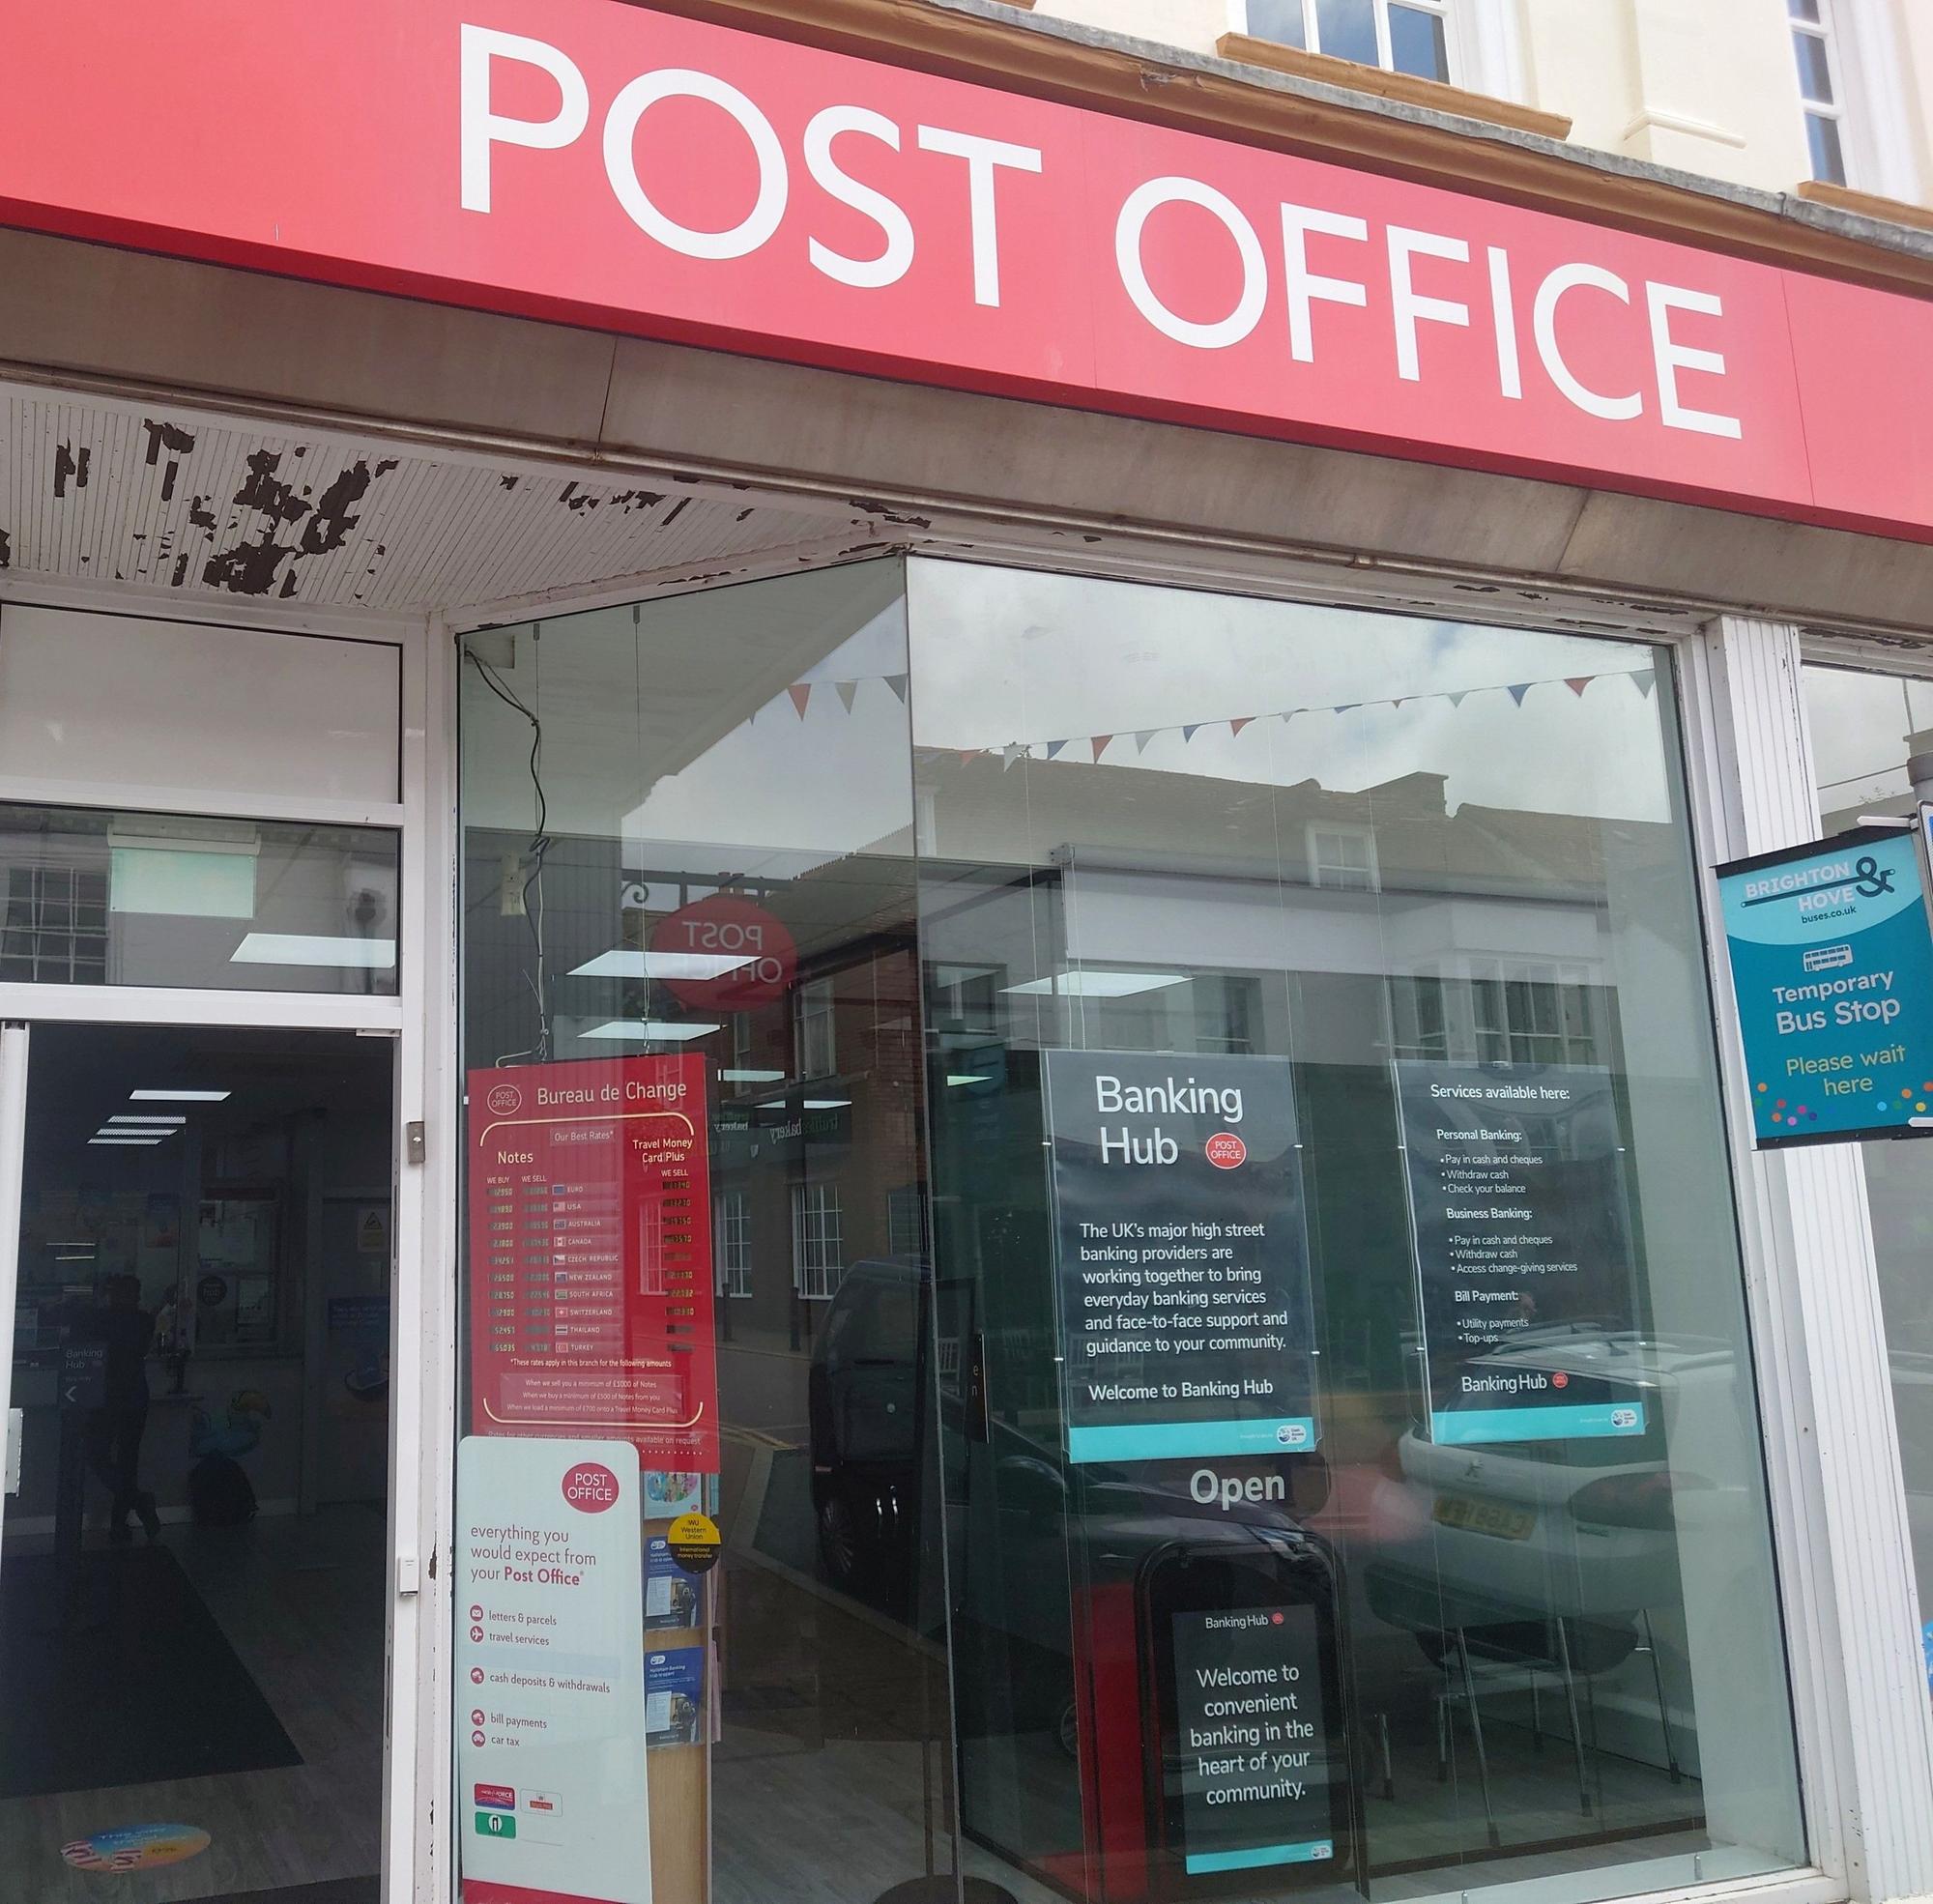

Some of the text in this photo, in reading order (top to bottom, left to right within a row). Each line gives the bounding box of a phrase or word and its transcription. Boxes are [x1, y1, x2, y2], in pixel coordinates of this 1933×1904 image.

[460, 22, 1742, 440] POST OFFICE
[1745, 861, 1851, 898] BRIGHTON
[1799, 886, 1856, 914] HOVE
[1802, 906, 1858, 924] buses.co.uk
[1773, 970, 1894, 1004] Temporary
[1776, 996, 1901, 1035] Bus Stop
[1786, 1044, 1906, 1077] Please wait
[537, 1081, 687, 1106] Bureau de Change
[1430, 1084, 1571, 1100] Services available here:
[1824, 1075, 1874, 1096] here
[492, 1098, 517, 1108] OFFICE
[496, 1091, 514, 1100] POST
[1095, 1075, 1244, 1124] Banking
[554, 1132, 568, 1142] Our
[570, 1131, 587, 1141] Best
[633, 1138, 693, 1149] Travel Money
[1436, 1129, 1522, 1142] Personal Banking:
[1100, 1126, 1179, 1165] Hub
[1215, 1140, 1237, 1151] POST
[497, 1151, 534, 1165] Notes
[642, 1152, 685, 1163] Card Plus
[1210, 1149, 1242, 1161] OFFICE
[1445, 1154, 1543, 1167] Pay in cash and cheques
[674, 1168, 689, 1177] SELL
[1447, 1169, 1509, 1179] Withdraw cash
[1448, 1184, 1526, 1195] Check your balance
[1447, 1208, 1533, 1222] Business Banking:
[1080, 1223, 1109, 1239] The
[1148, 1223, 1189, 1242] major
[1192, 1222, 1222, 1241] high
[1225, 1222, 1265, 1238] street
[1455, 1234, 1553, 1247] Pay in cash and cheques
[1081, 1245, 1233, 1265] banking providers are
[1456, 1249, 1517, 1259] Withdraw cash
[1457, 1261, 1577, 1275] Access change-giving services
[1082, 1267, 1261, 1287] working together to bring
[1084, 1290, 1266, 1310] everyday banking services
[1455, 1290, 1519, 1304] Bill Payment:
[1085, 1311, 1287, 1331] and face-to-face support and
[1462, 1318, 1529, 1330] Utility payments
[1086, 1334, 1286, 1358] guidance to your community.
[1463, 1333, 1498, 1344] Top-ups
[545, 1359, 560, 1369] apply
[579, 1359, 598, 1368] branch
[598, 1359, 608, 1368] for
[620, 1360, 646, 1370] following
[1088, 1379, 1274, 1401] Welcome to Banking Hub
[1461, 1376, 1517, 1394] Banking
[1519, 1374, 1547, 1391] Hub
[575, 1473, 607, 1486] POST
[567, 1486, 612, 1501] OFFICE
[1190, 1468, 1285, 1511] Open
[471, 1524, 569, 1544] everything you
[471, 1545, 596, 1566] would expect from
[471, 1569, 501, 1582] your
[505, 1568, 534, 1583] Post
[489, 1610, 557, 1627] letters & parcels
[1205, 1616, 1247, 1630] Banking
[1247, 1614, 1269, 1626] Hub
[489, 1632, 550, 1646] travel services
[490, 1673, 611, 1693] cash deposits & withdrawals
[1197, 1664, 1299, 1688] Welcome to
[1204, 1693, 1298, 1717] convenient
[491, 1713, 547, 1729] bill payments
[491, 1736, 520, 1746] car tax
[1190, 1720, 1313, 1747] banking in the
[1198, 1751, 1311, 1776] heart of your
[1206, 1780, 1306, 1805] community.
